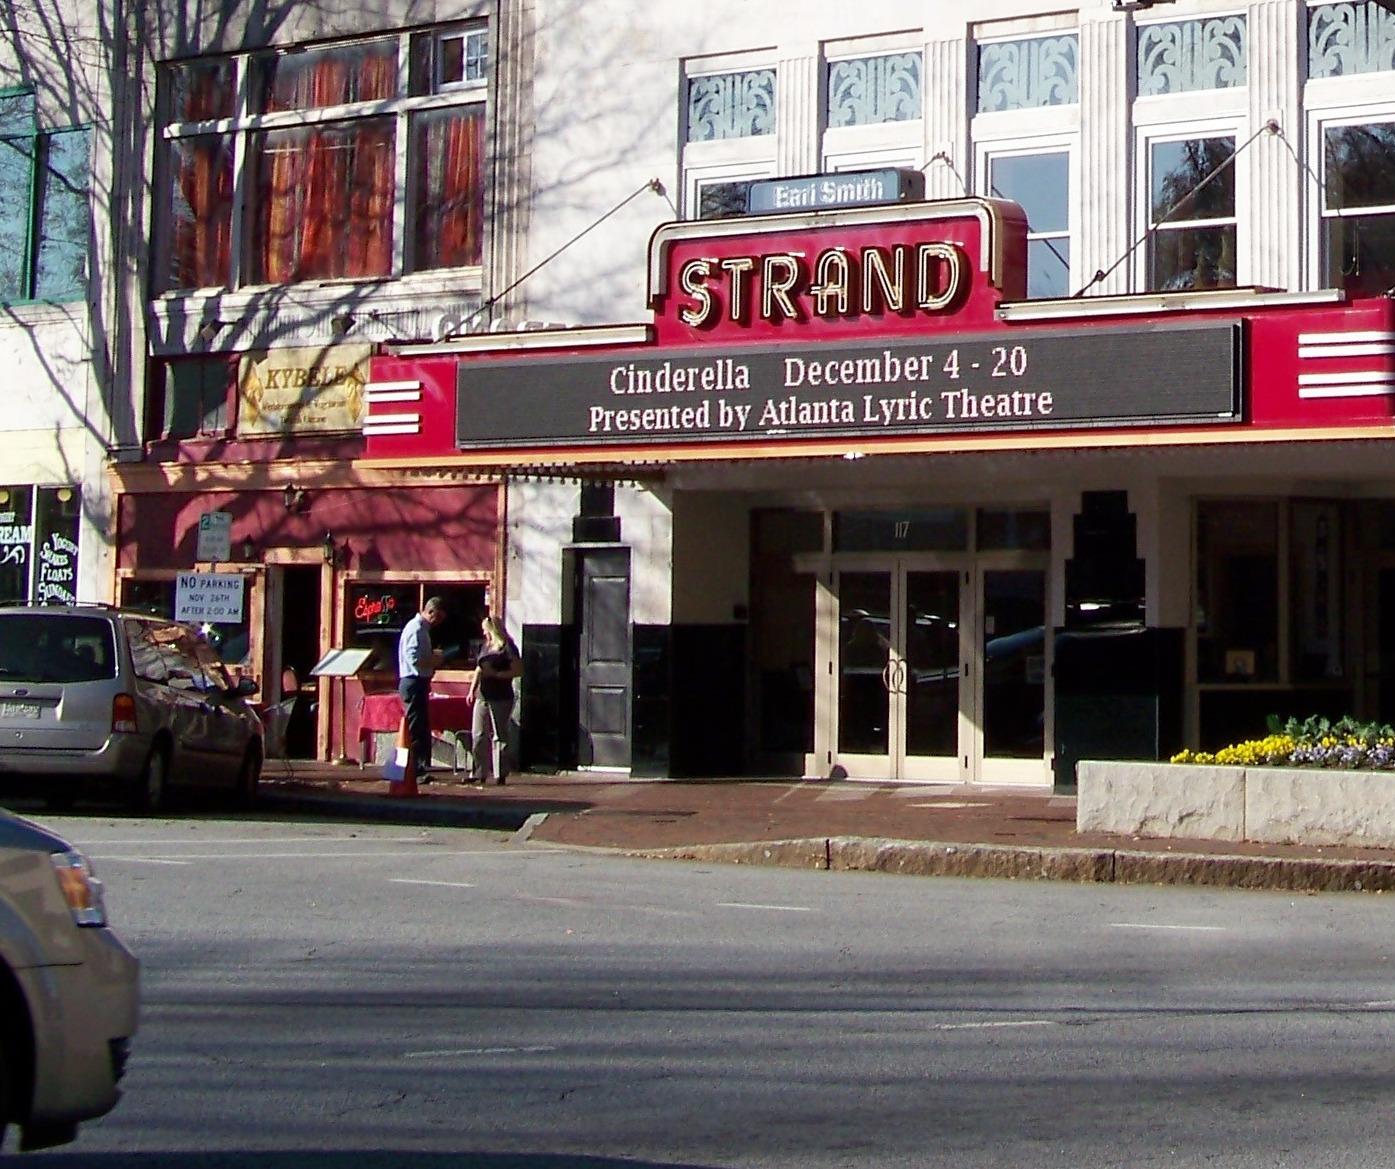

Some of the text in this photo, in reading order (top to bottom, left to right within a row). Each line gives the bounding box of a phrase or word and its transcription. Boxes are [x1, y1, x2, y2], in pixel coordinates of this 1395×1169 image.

[821, 178, 884, 204] Smith
[680, 241, 968, 329] STRAND
[609, 359, 751, 396] Cinderella
[784, 351, 934, 388] December
[942, 348, 961, 380] 4
[991, 346, 1028, 377] 20
[587, 387, 1054, 433] Presented by Atlanta Lyric Theatre
[895, 521, 910, 538] 117
[180, 576, 240, 590] NO PARKING
[181, 606, 205, 615] AFTER
[227, 607, 240, 616] AM
